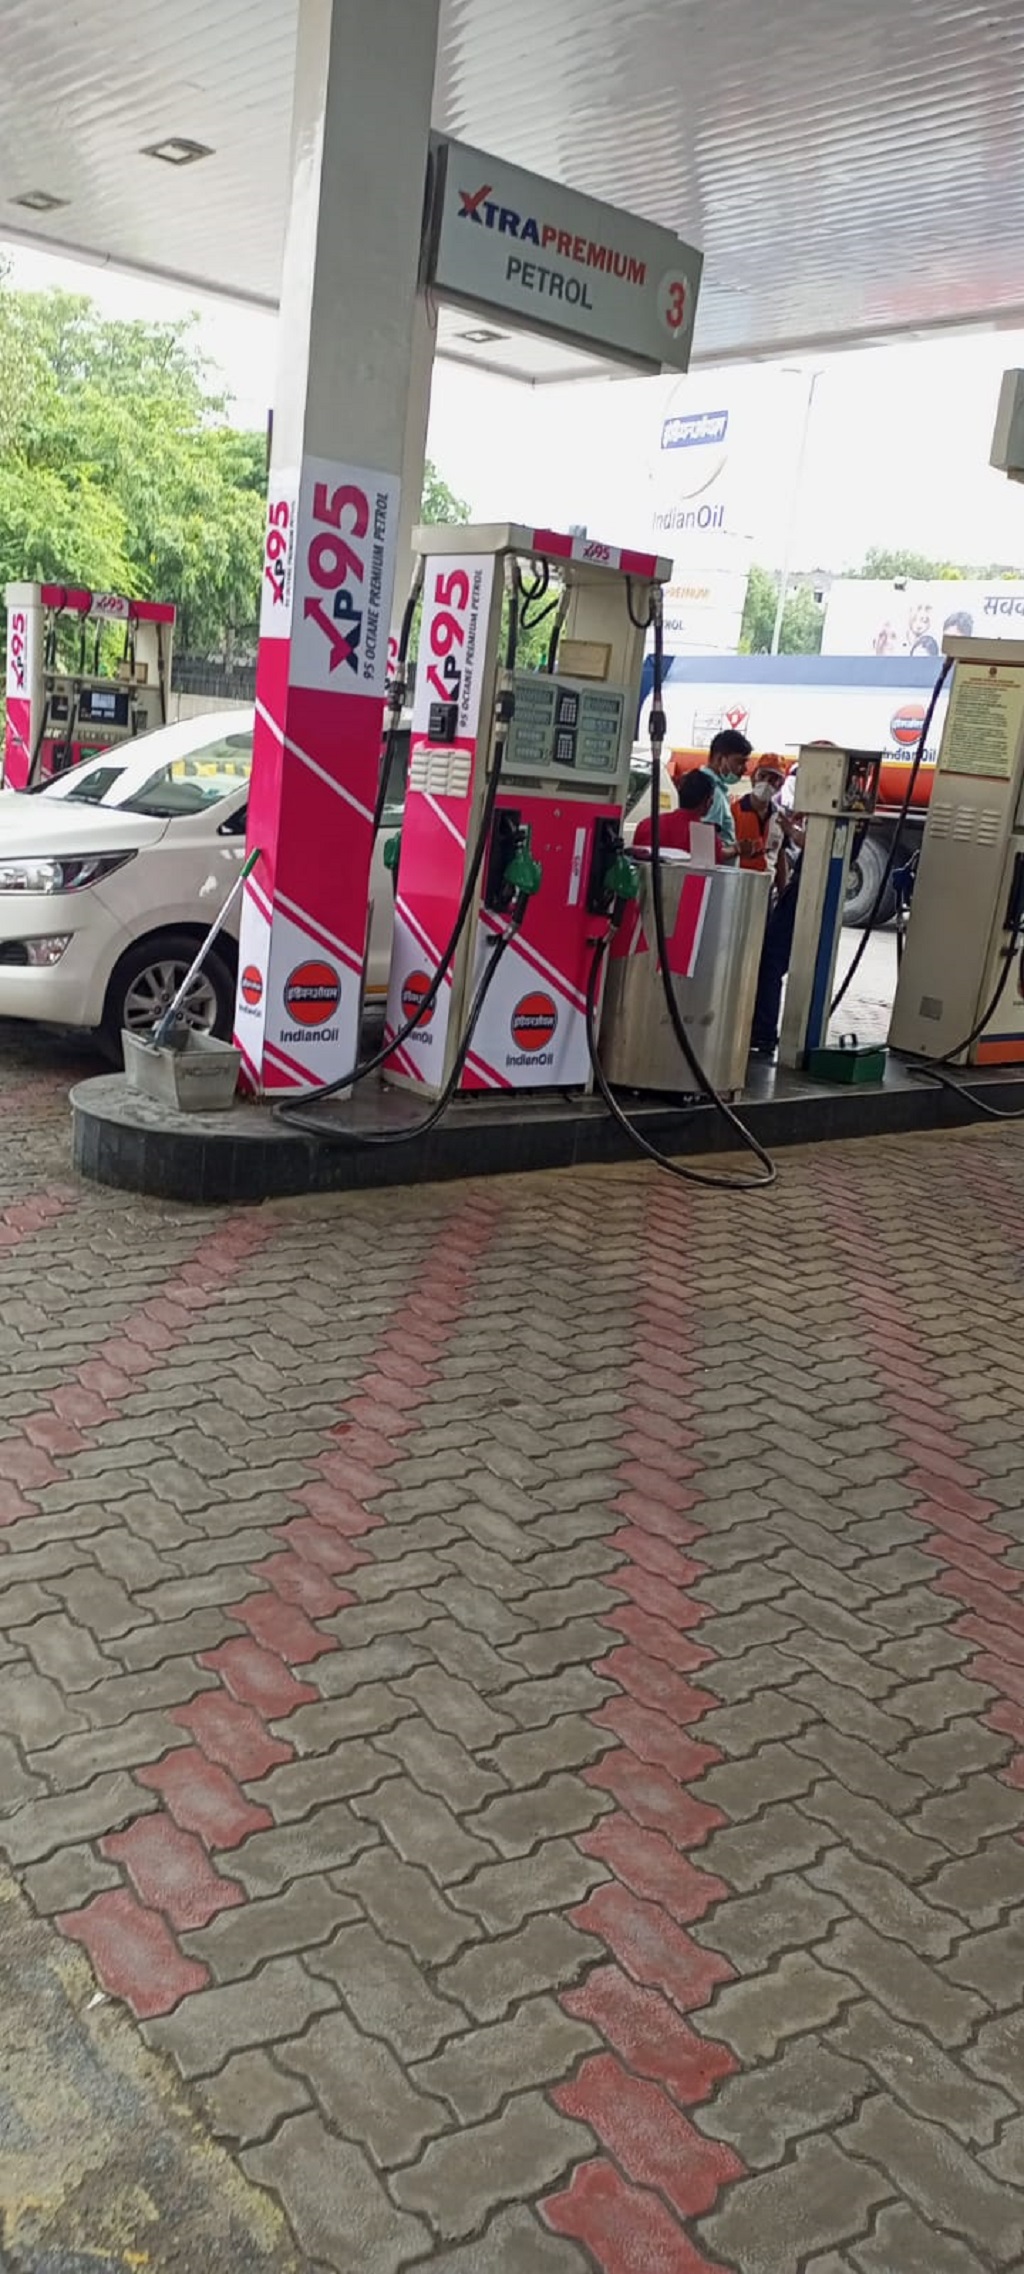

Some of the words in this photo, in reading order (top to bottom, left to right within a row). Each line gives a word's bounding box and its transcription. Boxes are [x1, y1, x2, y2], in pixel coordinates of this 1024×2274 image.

[505, 255, 593, 310] PETROL
[665, 282, 686, 329] 3
[374, 492, 389, 541] PETROL
[652, 505, 725, 530] IndianOil
[265, 501, 289, 606] XP95
[304, 481, 370, 675] XP95
[369, 545, 385, 607] PREMIUM
[471, 569, 483, 611] PETROL
[11, 613, 24, 688] XP95
[365, 609, 380, 659] OCTANE
[426, 569, 470, 702] XP95
[466, 613, 479, 666] PREMIUM
[363, 662, 375, 680] 95
[461, 669, 473, 711] OCTANE
[280, 1028, 339, 1042] IndianOil
[506, 1053, 554, 1067] IndianOil
